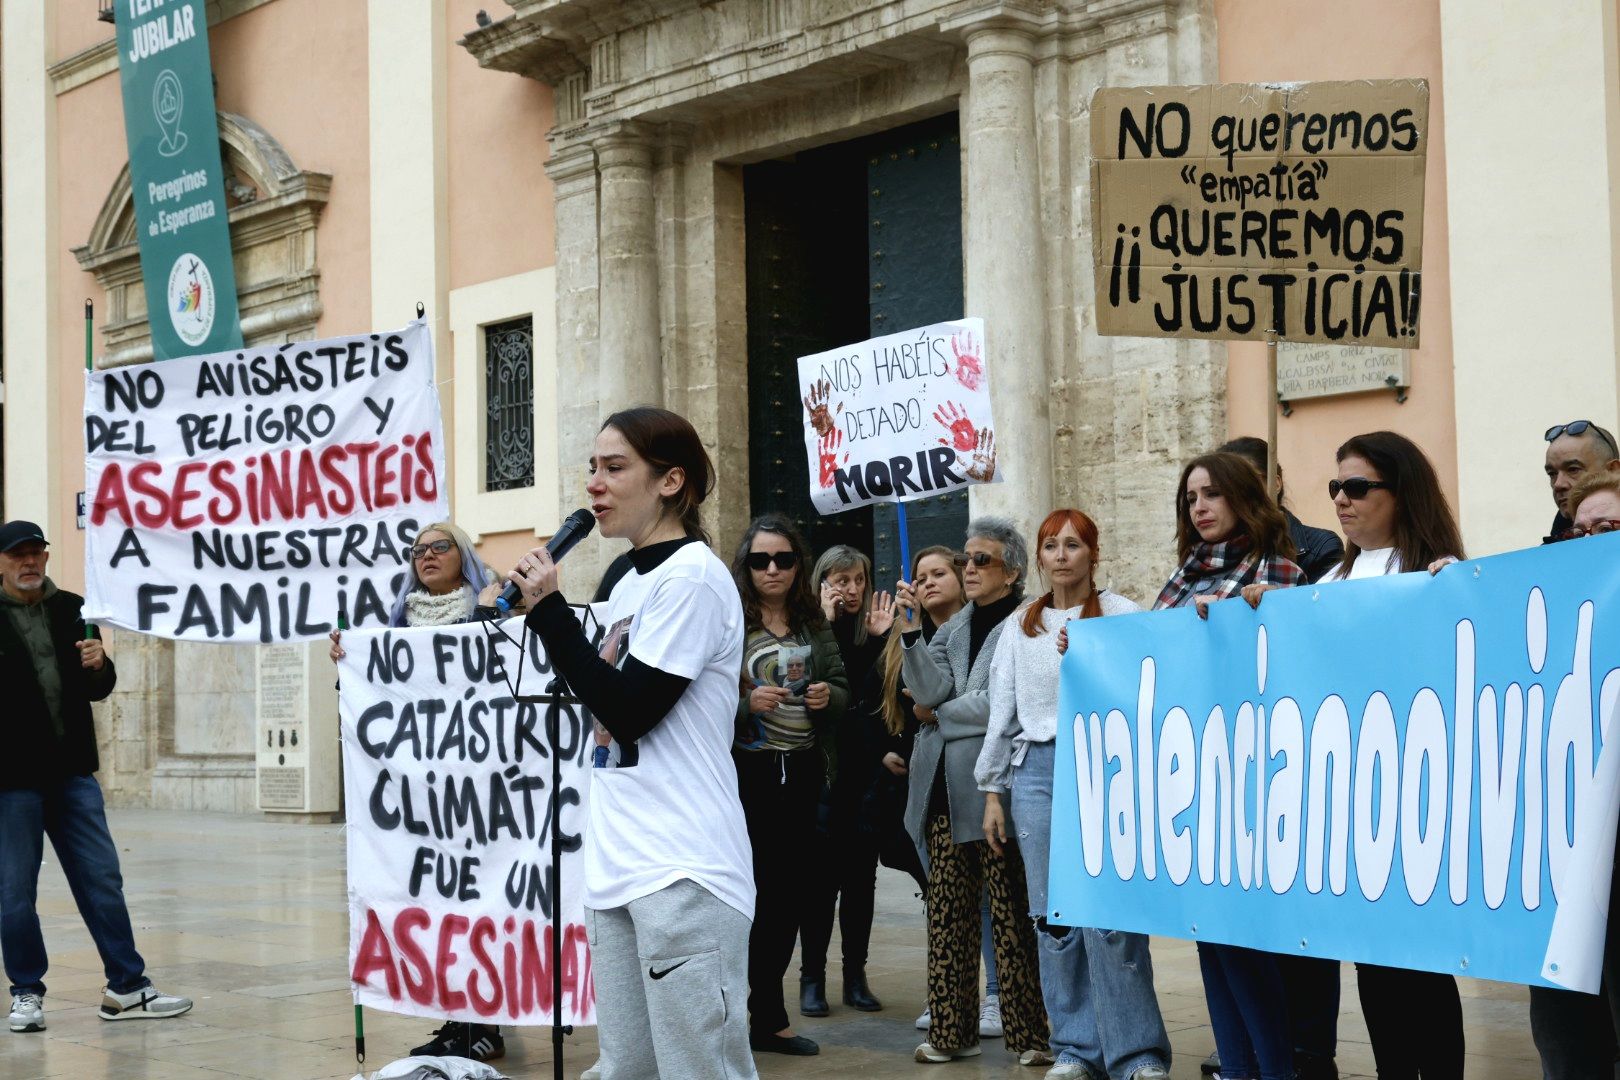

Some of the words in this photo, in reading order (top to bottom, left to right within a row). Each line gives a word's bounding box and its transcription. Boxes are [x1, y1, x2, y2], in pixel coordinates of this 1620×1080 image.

[129, 4, 196, 63] JUBILAR
[1118, 102, 1190, 160] NO
[1211, 108, 1418, 171] queremos
[148, 169, 208, 205] Peregrinos
[158, 199, 216, 235] Esperanza
[104, 369, 165, 412] NO
[819, 354, 862, 396] NOS
[86, 415, 155, 454] DEL
[363, 396, 394, 435] Y
[845, 397, 921, 442] DEJADO
[833, 446, 967, 504] MORIR
[110, 528, 150, 567] A
[193, 519, 419, 570] NUESTRAS
[367, 630, 414, 685] NO
[433, 633, 506, 683] FUE
[505, 858, 553, 919] UN
[353, 907, 597, 1022] ASESINAT
